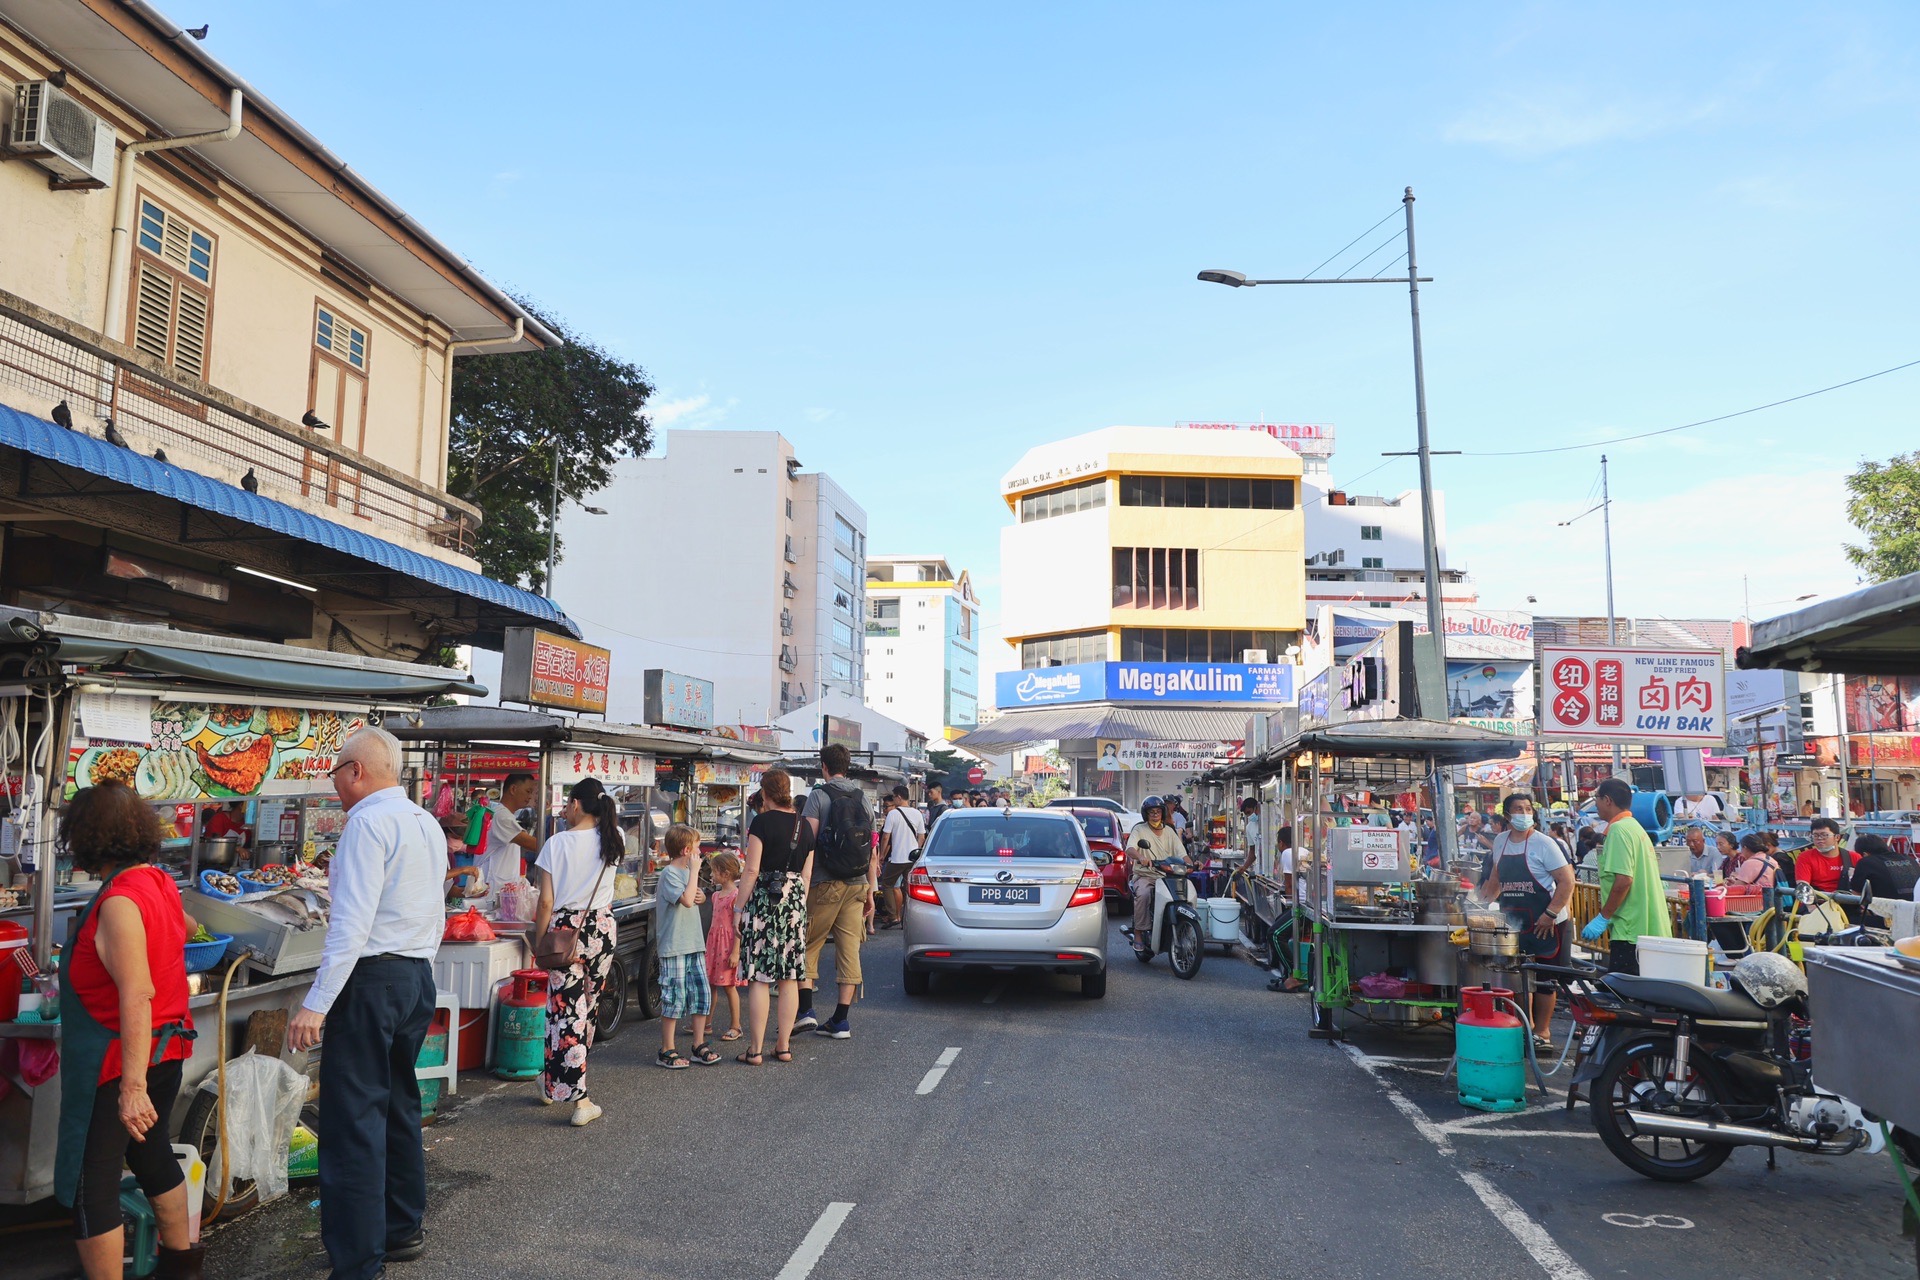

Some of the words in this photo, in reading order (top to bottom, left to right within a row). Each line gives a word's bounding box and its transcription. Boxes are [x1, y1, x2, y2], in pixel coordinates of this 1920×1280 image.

[1472, 617, 1531, 640] World
[1635, 657, 1655, 666] NEW
[1657, 658, 1678, 666] LINE
[1680, 658, 1715, 667] FAMOUS
[1248, 667, 1285, 675] FARMASI
[1653, 666, 1673, 674] DEEP
[533, 677, 548, 694] WAN
[549, 680, 561, 696] TAN
[561, 682, 575, 699] MEE
[1119, 668, 1243, 696] MegaKulim
[1558, 663, 1584, 721] 纽冷
[1600, 663, 1619, 722] 老招牌
[1639, 674, 1714, 713] 卤肉
[1636, 715, 1671, 730] LOH
[1676, 716, 1714, 732] BAK
[1189, 742, 1217, 750] KOSONG
[1158, 751, 1196, 759] PEMBANTU
[302, 755, 333, 773] IKAN
[1145, 760, 1163, 769] 012
[1171, 760, 1189, 769] 665
[981, 888, 1002, 900] PPB
[1005, 889, 1029, 900] 4021
[503, 1021, 521, 1030] GAS
